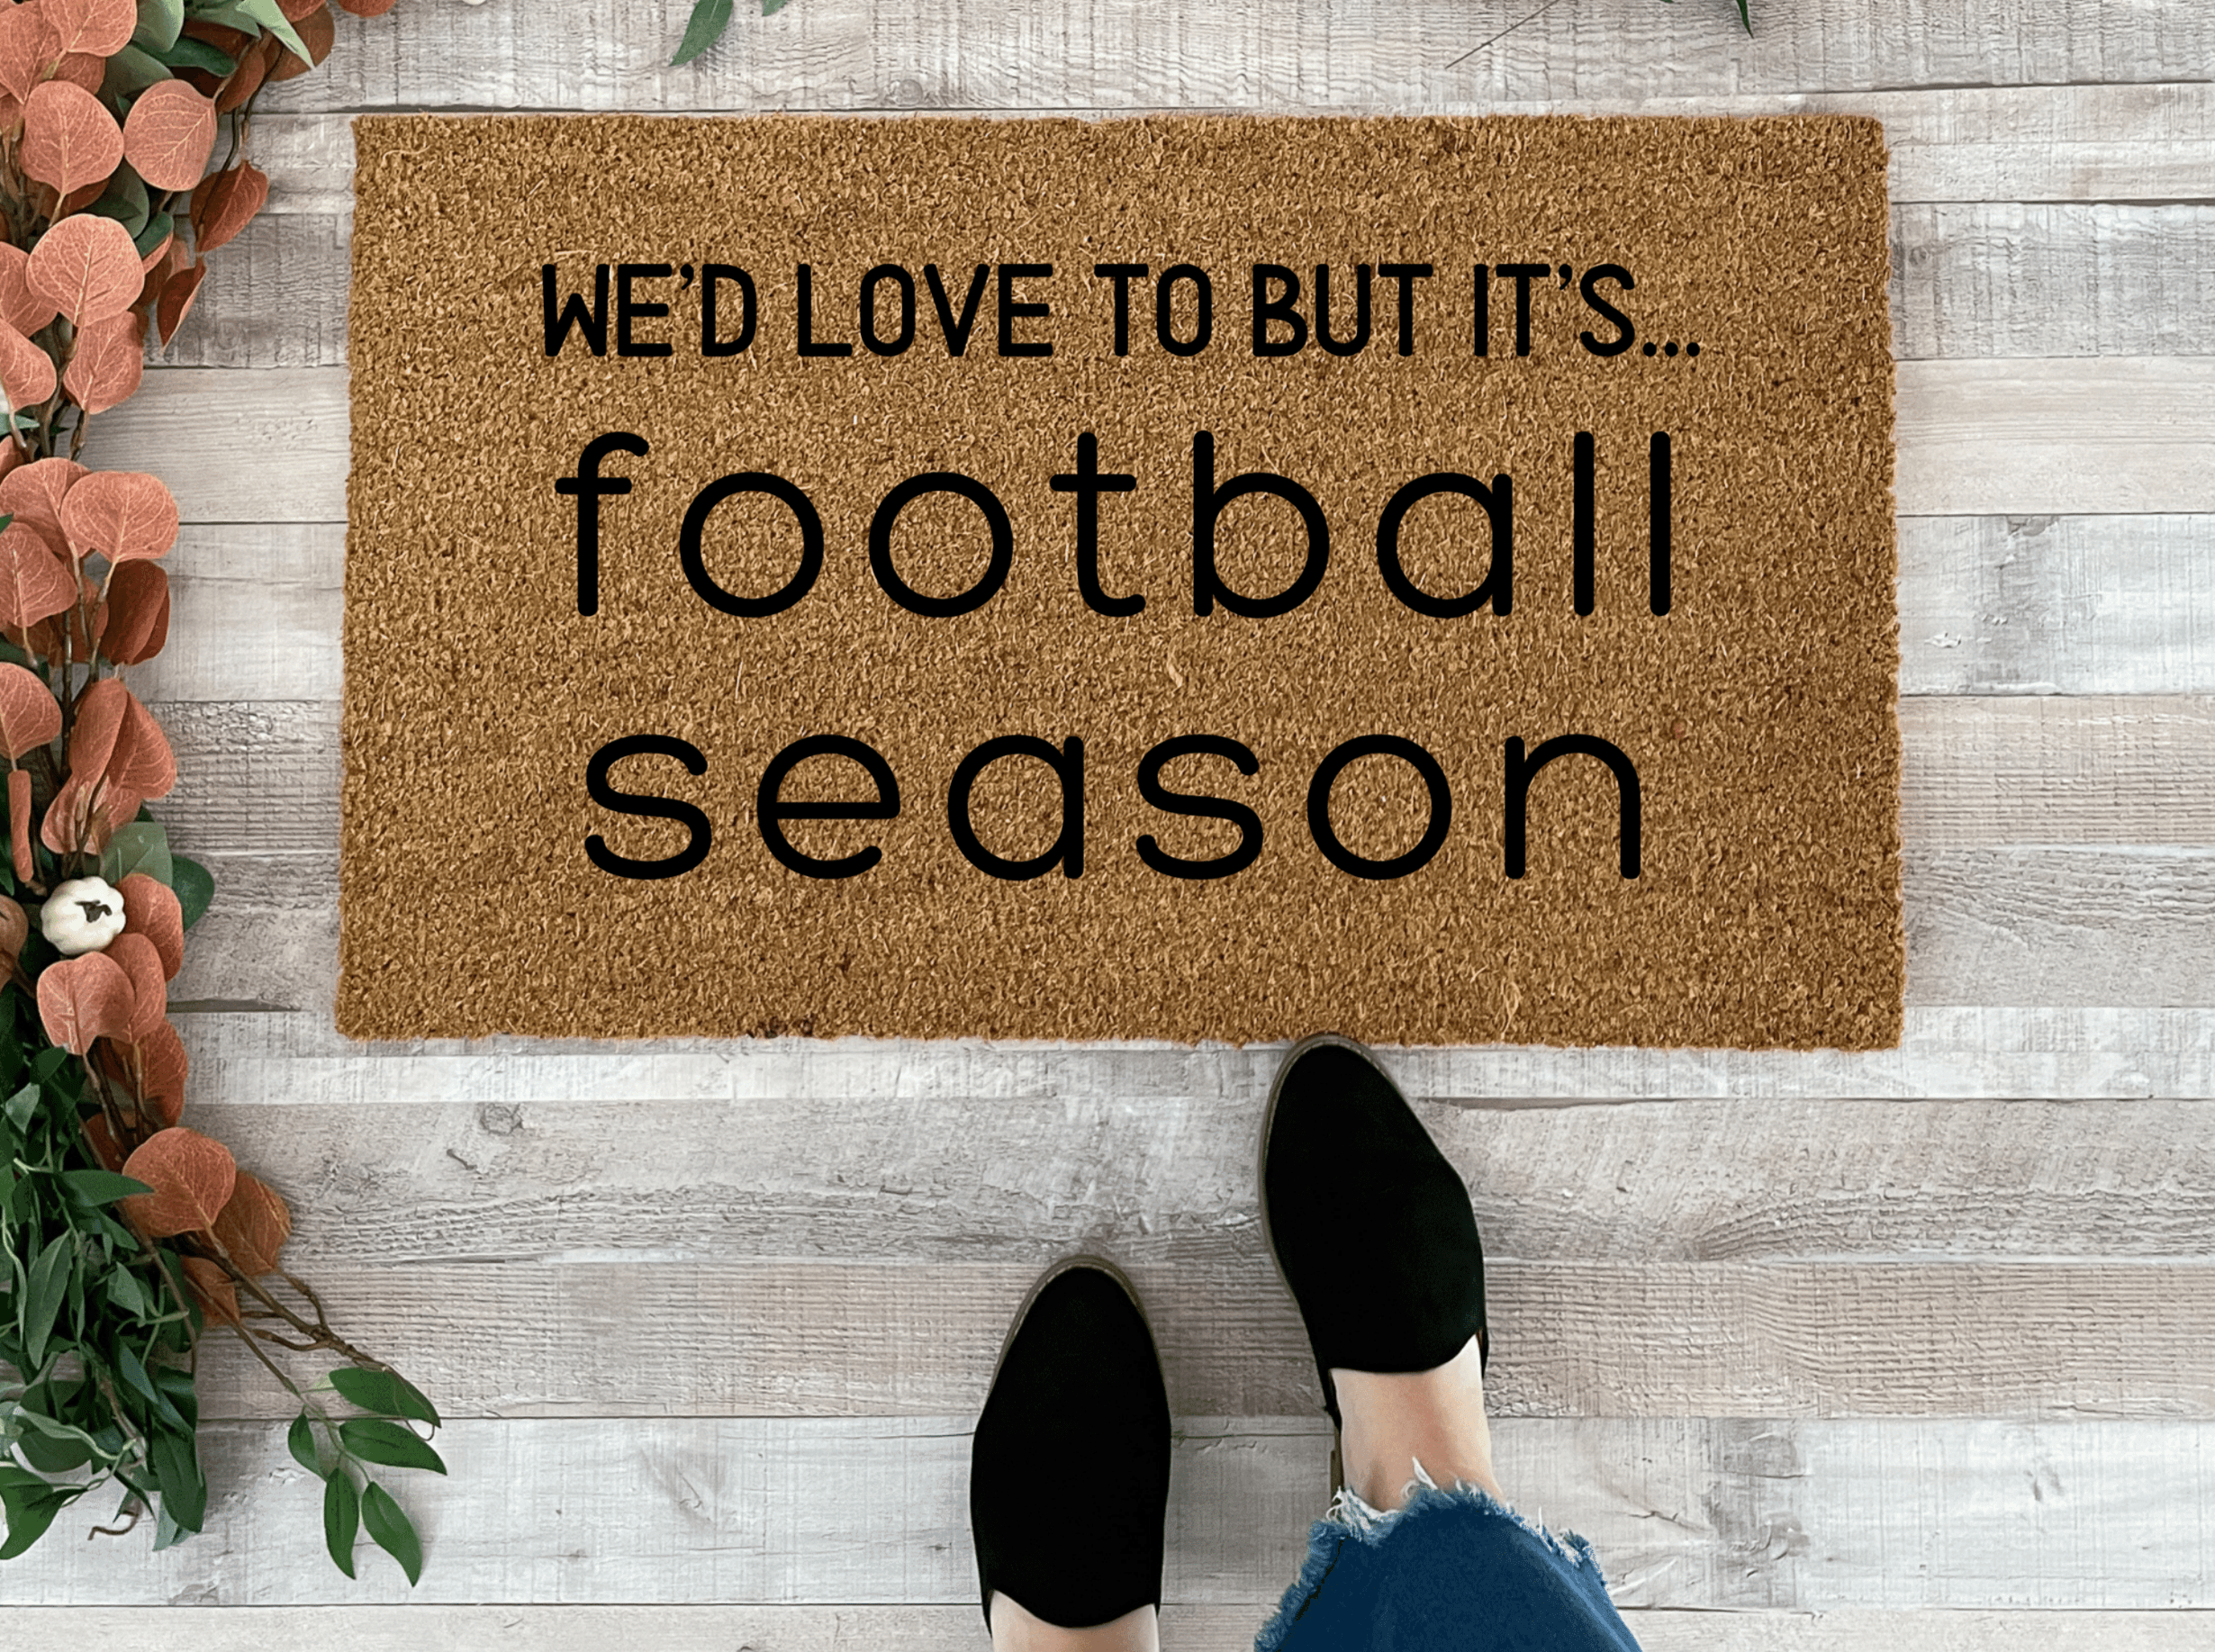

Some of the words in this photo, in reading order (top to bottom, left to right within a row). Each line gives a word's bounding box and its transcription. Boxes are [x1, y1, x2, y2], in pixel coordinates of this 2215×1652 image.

[541, 262, 758, 358] WE'D
[794, 262, 1055, 359] LOVE
[1092, 262, 1214, 359] TO
[1251, 262, 1435, 358] BUT
[554, 429, 1673, 620] football
[583, 732, 1642, 881] season
